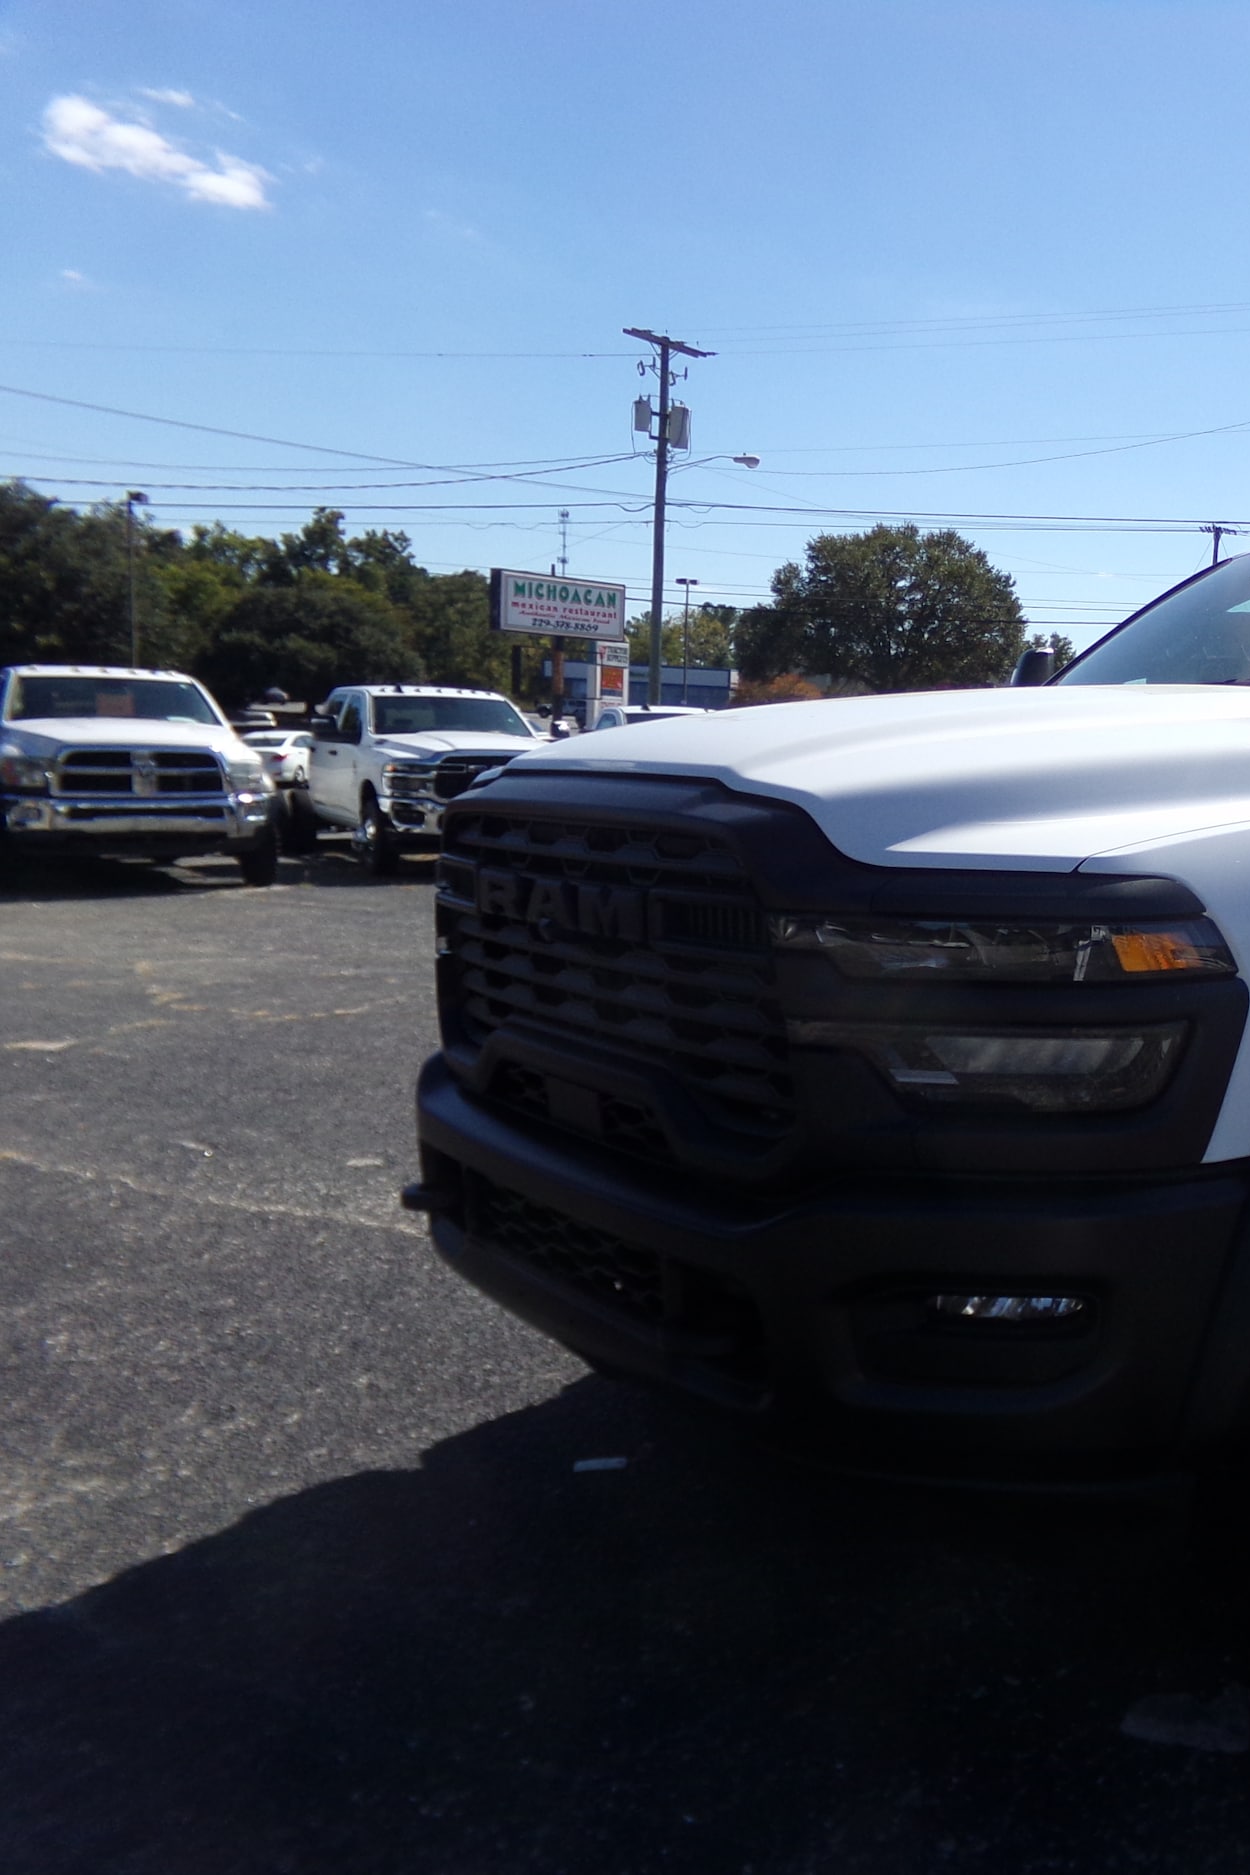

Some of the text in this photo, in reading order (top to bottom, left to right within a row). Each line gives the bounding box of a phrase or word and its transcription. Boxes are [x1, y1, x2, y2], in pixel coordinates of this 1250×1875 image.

[513, 580, 616, 608] MICHOACAN
[511, 601, 617, 619] mexican restaurant
[479, 867, 645, 942] RAM
